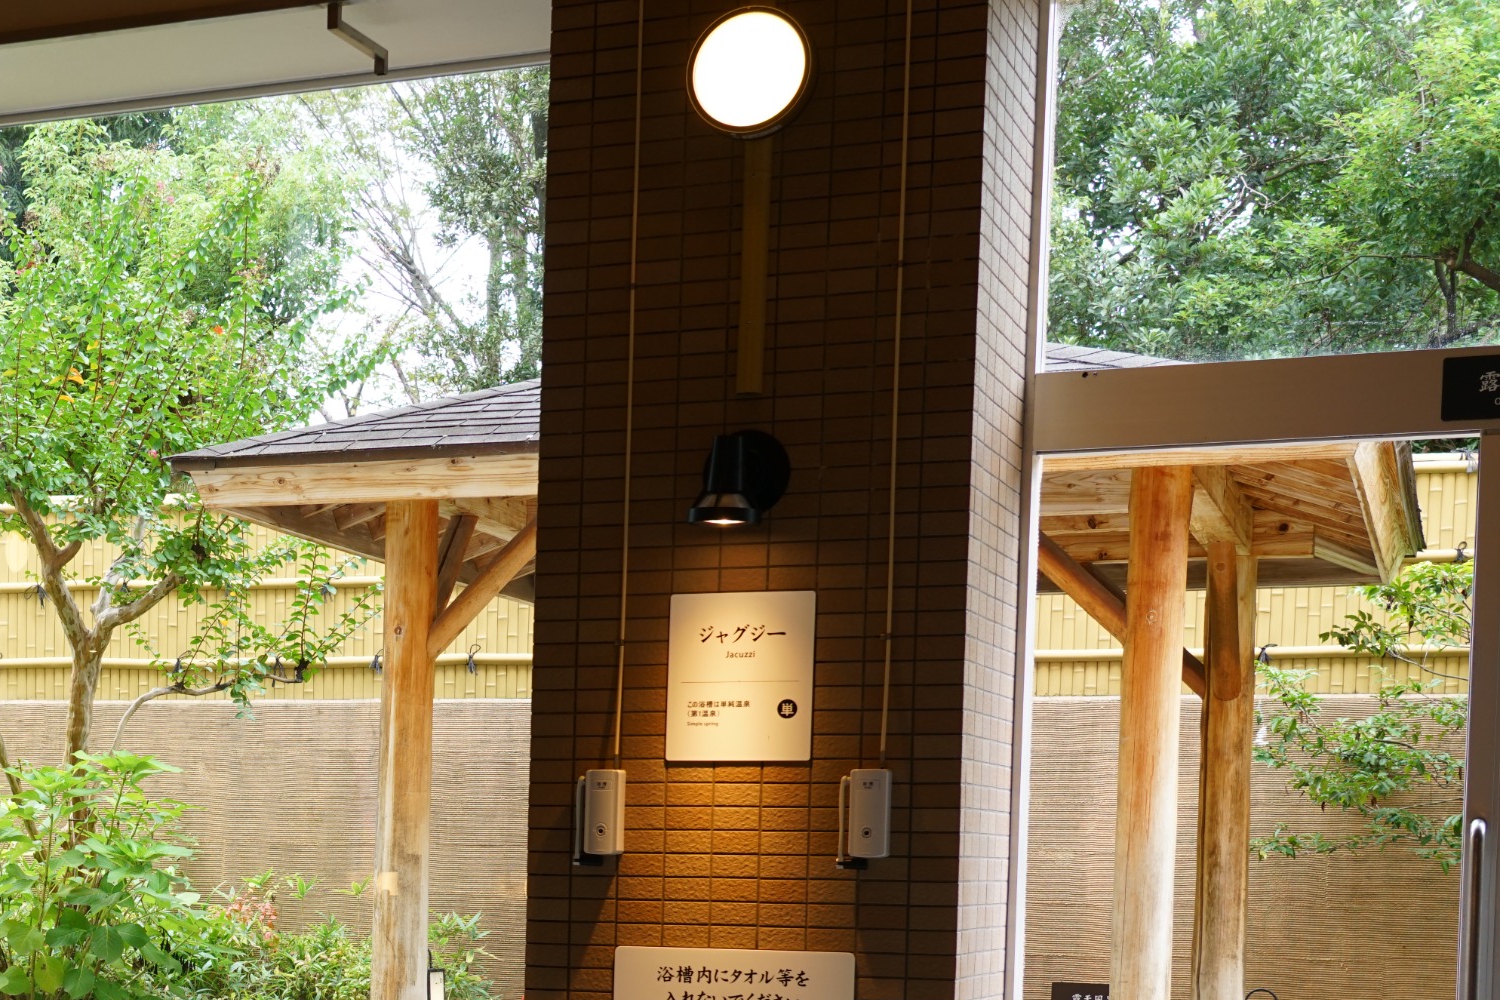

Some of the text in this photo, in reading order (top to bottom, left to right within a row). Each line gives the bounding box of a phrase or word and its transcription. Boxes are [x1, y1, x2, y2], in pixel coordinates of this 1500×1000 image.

[699, 624, 787, 644] ジャグジー
[725, 650, 756, 659] Jacuzzi
[780, 703, 795, 716] 単
[657, 966, 810, 987] 浴槽内にタオル等を
